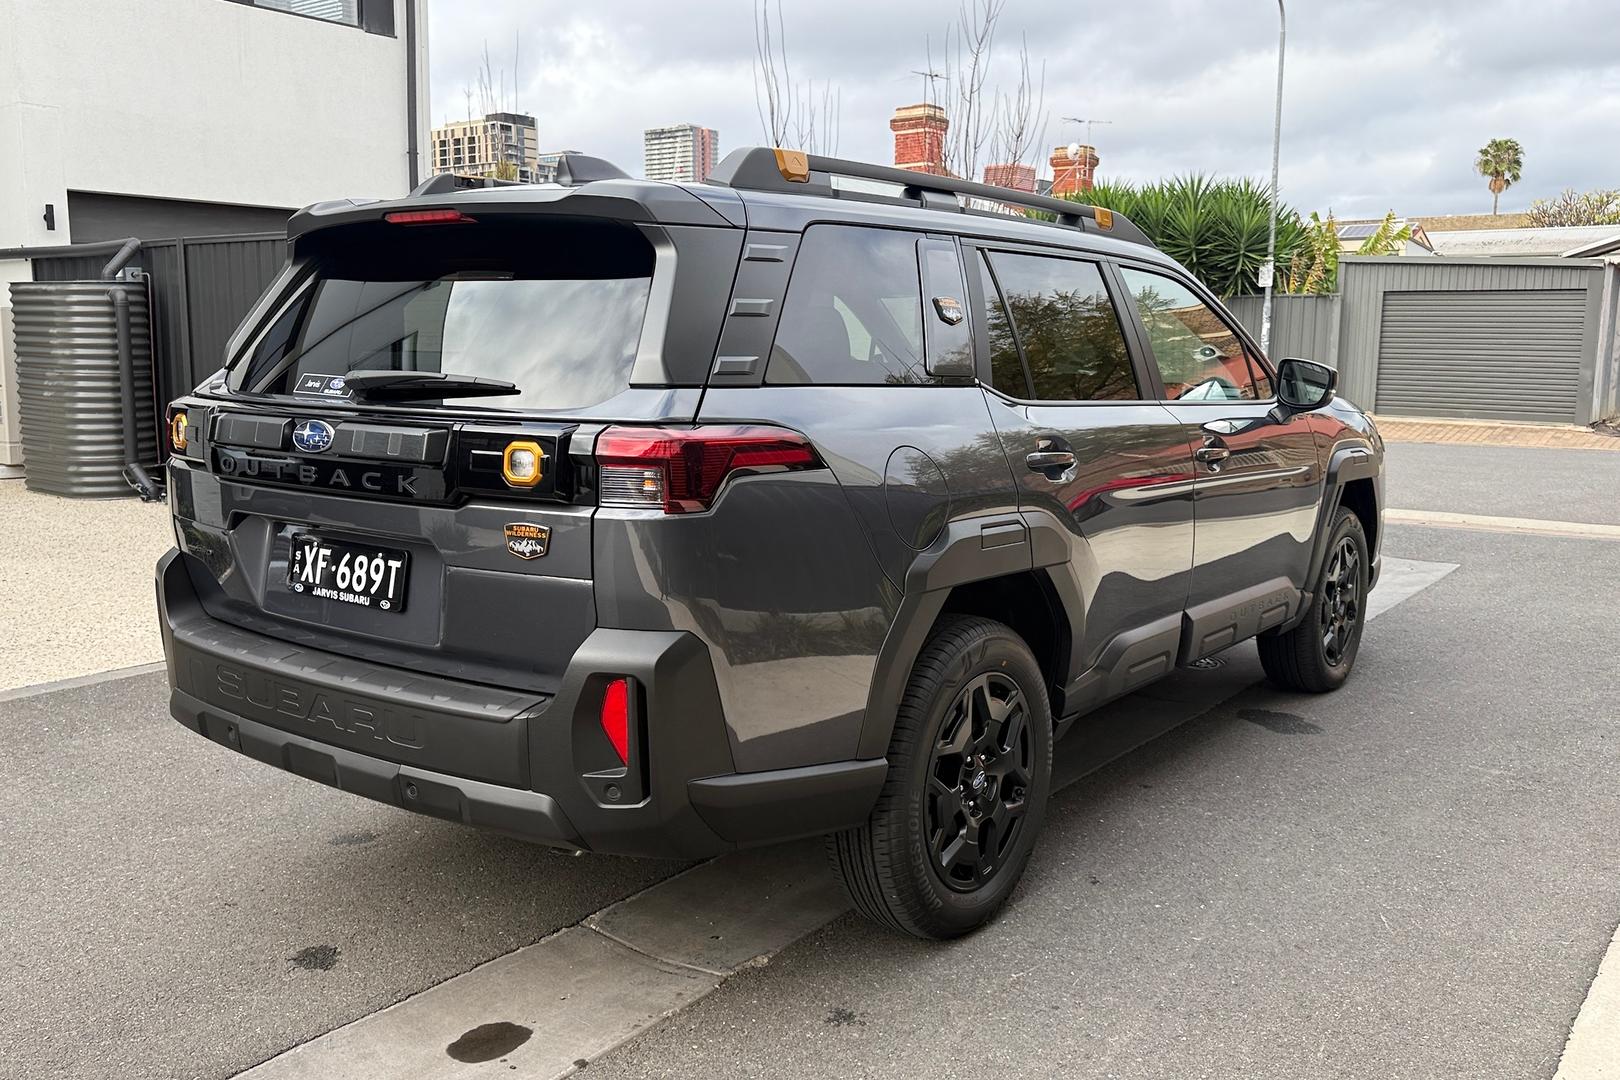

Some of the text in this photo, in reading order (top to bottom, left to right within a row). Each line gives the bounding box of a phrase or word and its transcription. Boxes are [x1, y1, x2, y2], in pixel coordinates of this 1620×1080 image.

[220, 457, 418, 495] OUTBACK
[505, 530, 547, 539] WILDERNESS
[512, 525, 540, 533] SUBARU
[312, 586, 370, 606] JARVIS SUBARU
[215, 663, 425, 750] SUBARU
